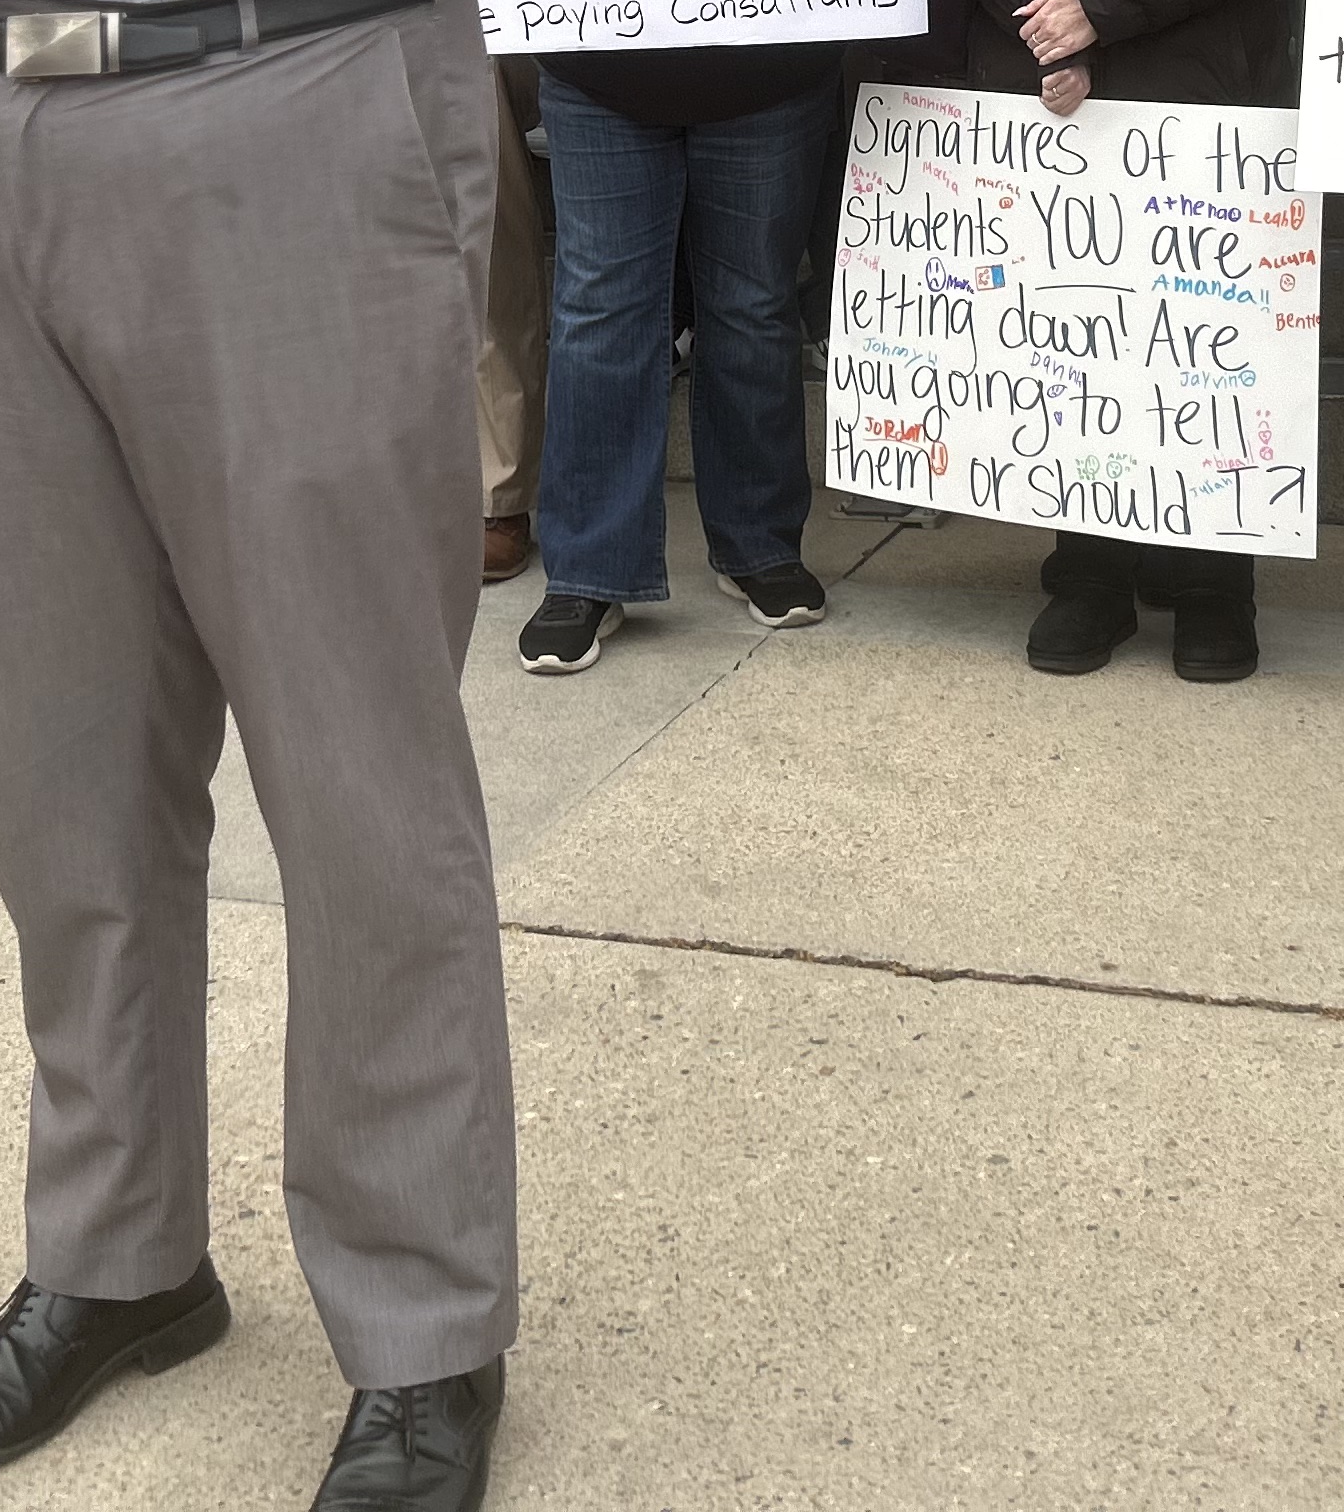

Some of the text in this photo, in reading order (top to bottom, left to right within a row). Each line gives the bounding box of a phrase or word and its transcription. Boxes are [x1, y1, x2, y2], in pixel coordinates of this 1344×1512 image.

[516, 0, 645, 40] paying
[854, 95, 1088, 196] Signatures
[1122, 115, 1181, 182] of
[1205, 121, 1297, 196] the
[1030, 184, 1123, 270] YOU
[1151, 224, 1253, 280] are
[841, 268, 1250, 378] letting down! Are
[834, 354, 1248, 459] you going to tell
[831, 418, 934, 502] them
[970, 456, 1016, 513] or
